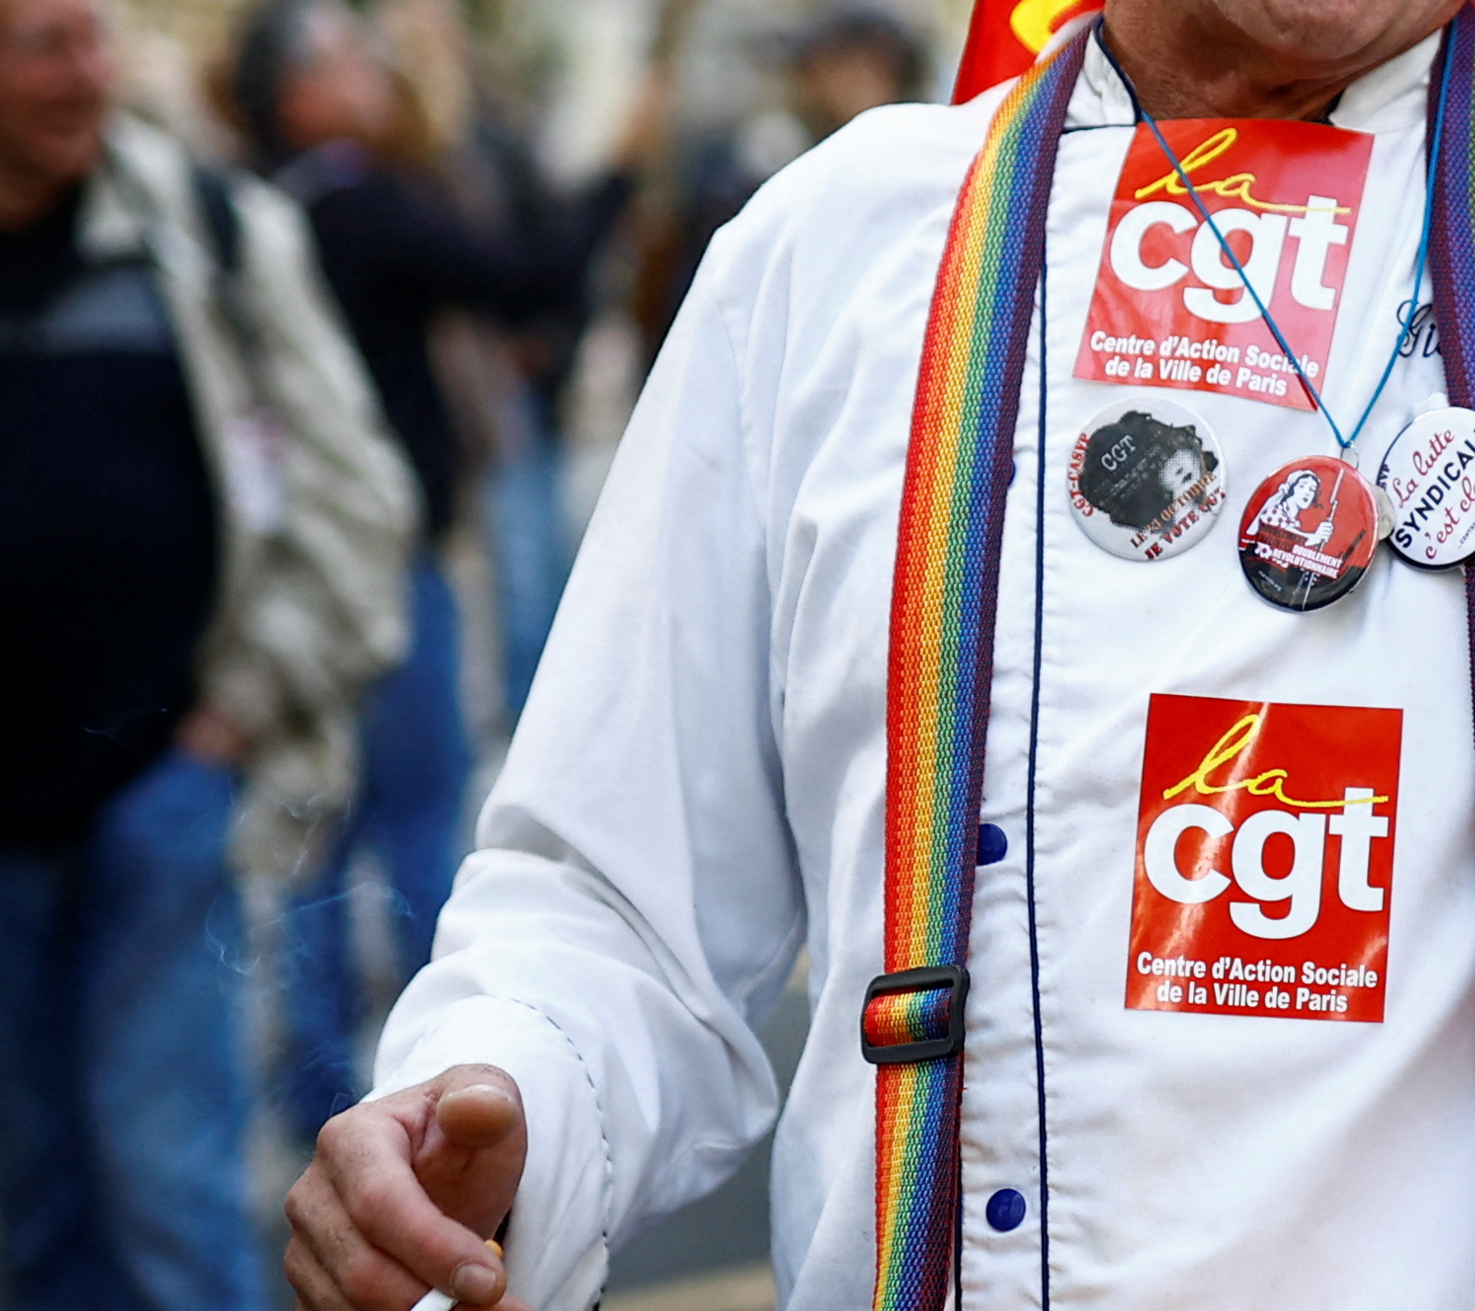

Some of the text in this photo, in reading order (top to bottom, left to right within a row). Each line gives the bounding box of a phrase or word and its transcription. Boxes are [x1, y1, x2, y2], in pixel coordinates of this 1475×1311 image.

[1135, 128, 1351, 213] la
[1109, 196, 1351, 324] cgt
[1091, 330, 1155, 355] Centre
[1159, 335, 1240, 363] d'Action
[1105, 356, 1287, 396] de la Ville de Paris
[1101, 434, 1136, 471] CGT
[1392, 430, 1455, 509] La lutte
[1161, 511, 1199, 544] VOTE
[1163, 714, 1388, 808] la
[1144, 787, 1389, 939] cgt
[1137, 951, 1378, 988] Centre d'Action Sociale
[1156, 980, 1348, 1013] de la Ville de Paris
